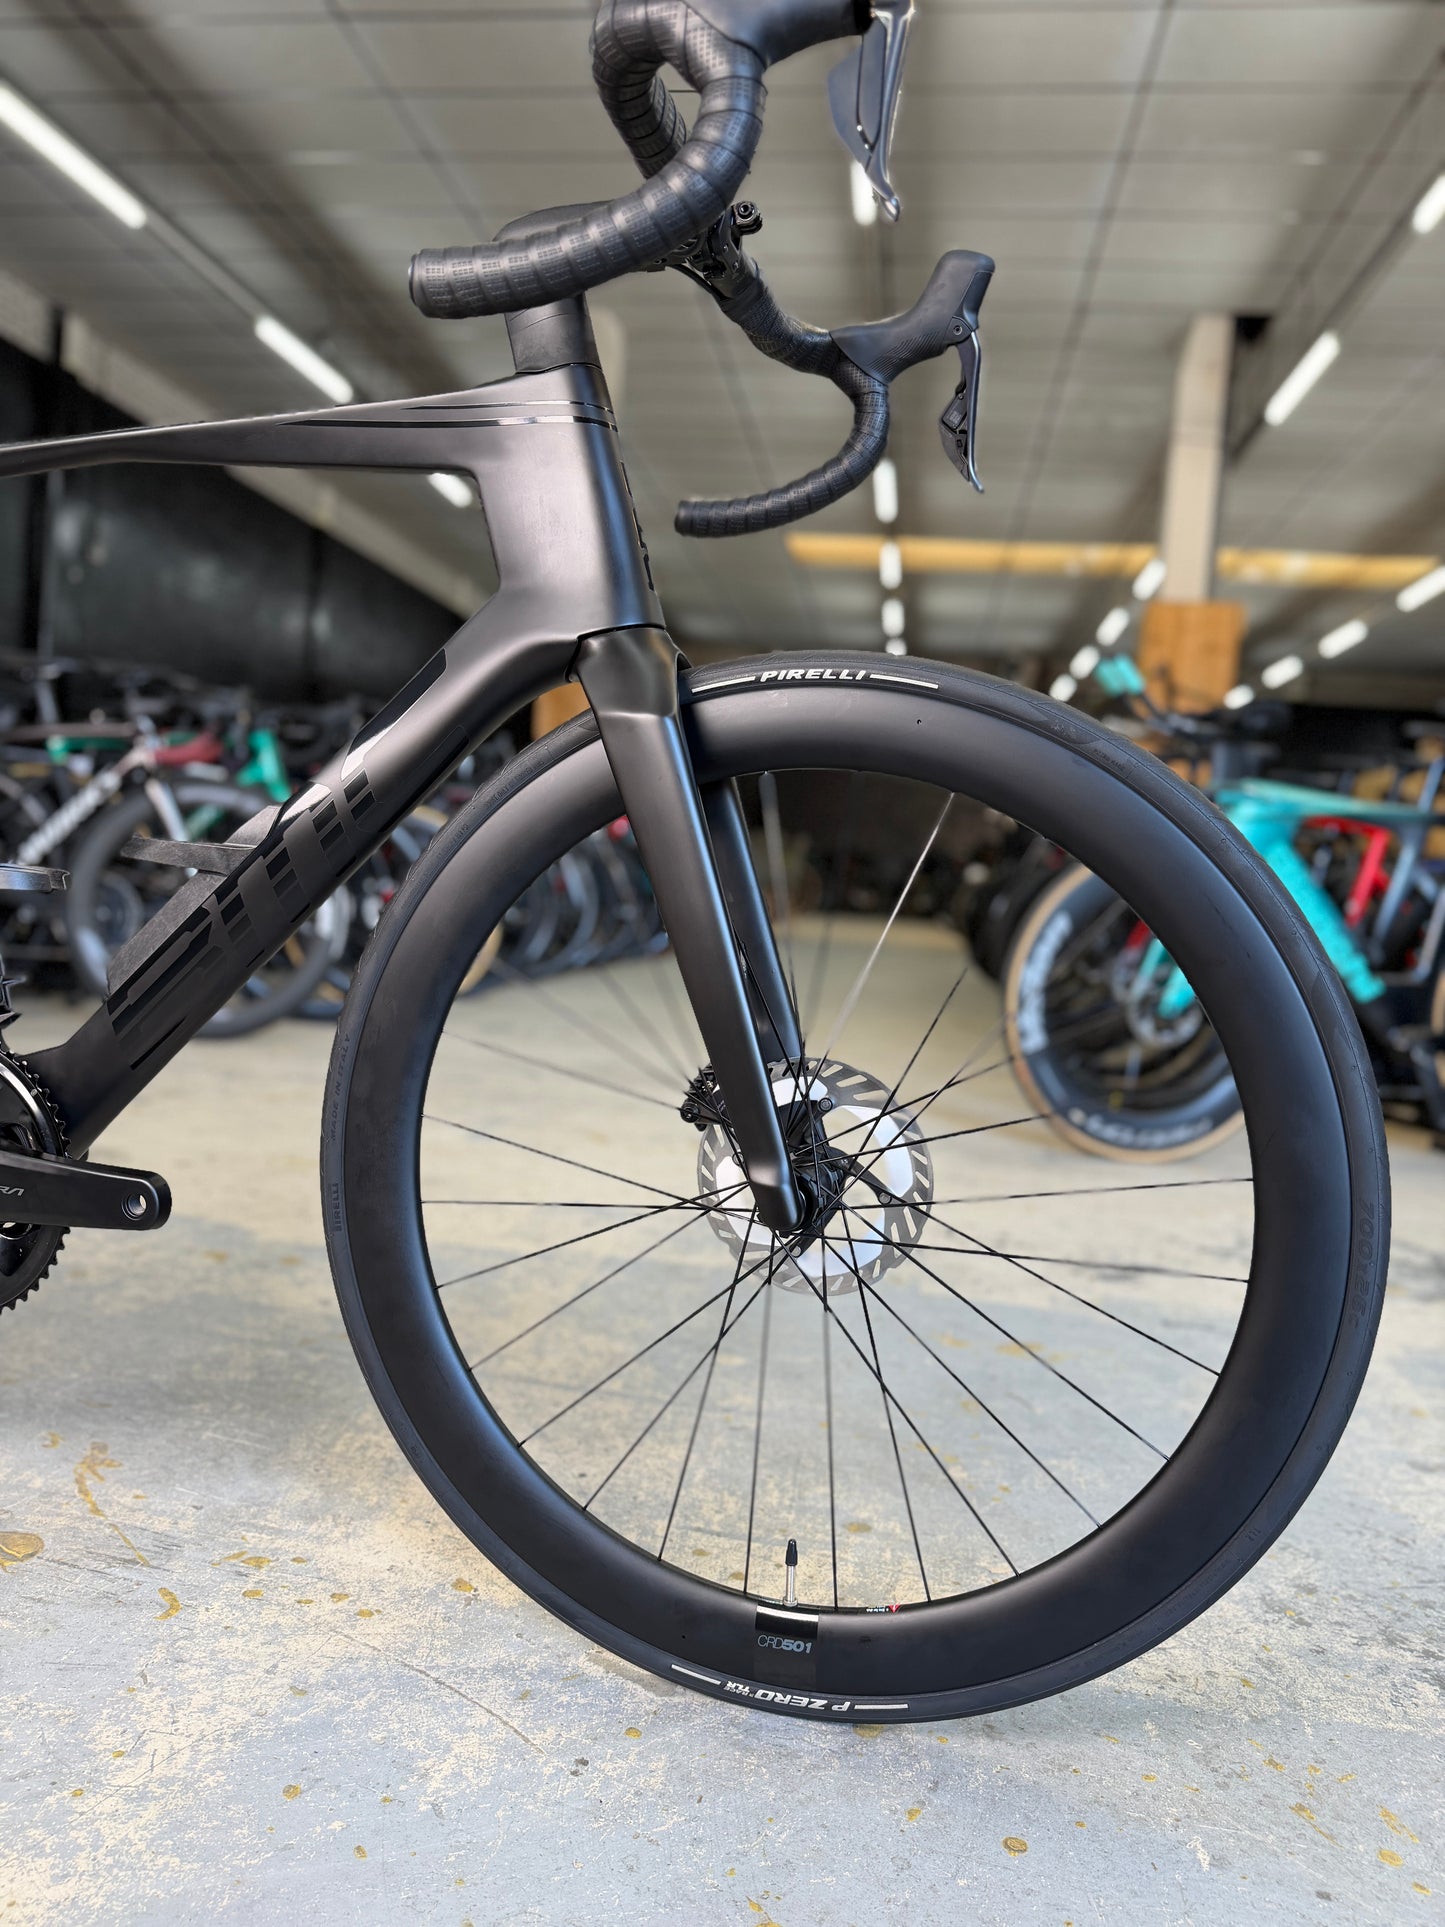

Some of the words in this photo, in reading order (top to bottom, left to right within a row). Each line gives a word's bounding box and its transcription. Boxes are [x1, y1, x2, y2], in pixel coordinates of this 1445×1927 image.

[760, 668, 866, 682] PIRELLI
[330, 1102, 339, 1141] MADE
[338, 1034, 350, 1080] ITALY
[757, 1635, 813, 1654] CRD501
[726, 1681, 750, 1693] TLR
[755, 1689, 828, 1710] ZERO
[831, 1701, 851, 1712] P
